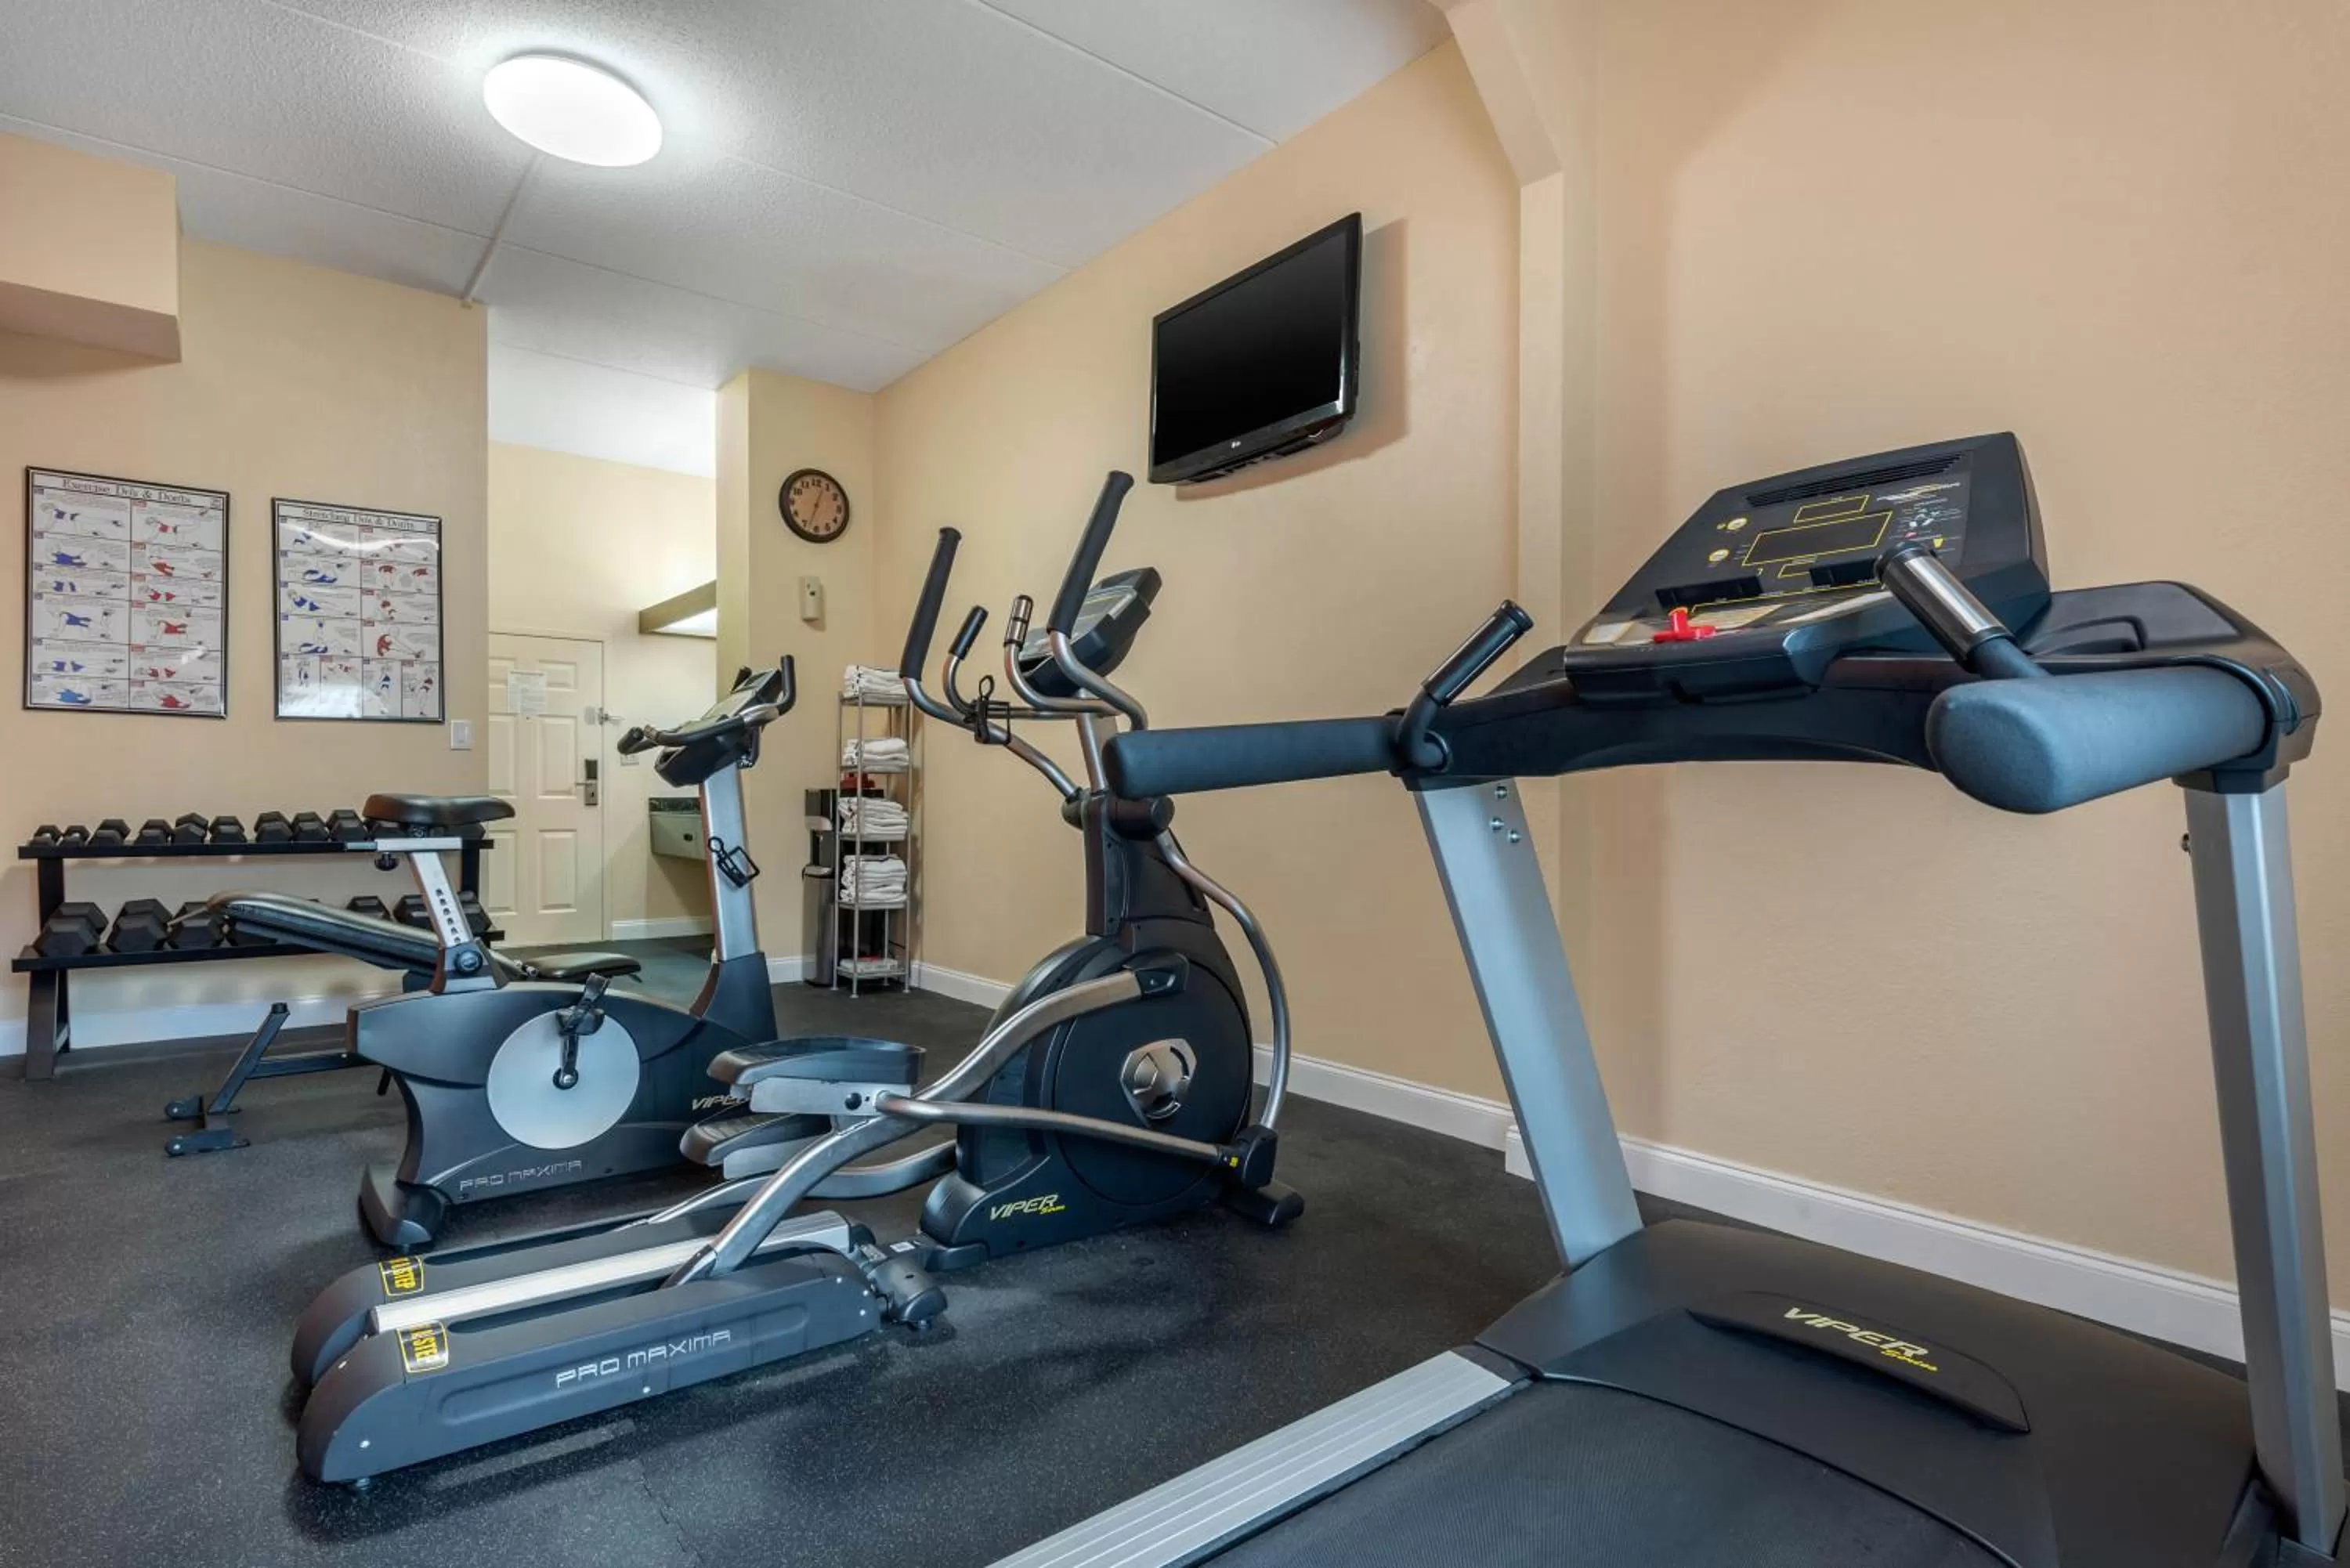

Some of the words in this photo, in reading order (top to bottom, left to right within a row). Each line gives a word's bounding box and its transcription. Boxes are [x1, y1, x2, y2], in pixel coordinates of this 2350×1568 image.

[63, 479, 110, 493] Exercise
[142, 490, 153, 500] &
[460, 1175, 504, 1190] PRO
[508, 1160, 582, 1184] MAXIMA
[990, 1194, 1058, 1220] VIPER
[1784, 1307, 1929, 1357] VIPER
[555, 1357, 620, 1389] PRO
[627, 1330, 732, 1370] MAXIMA
